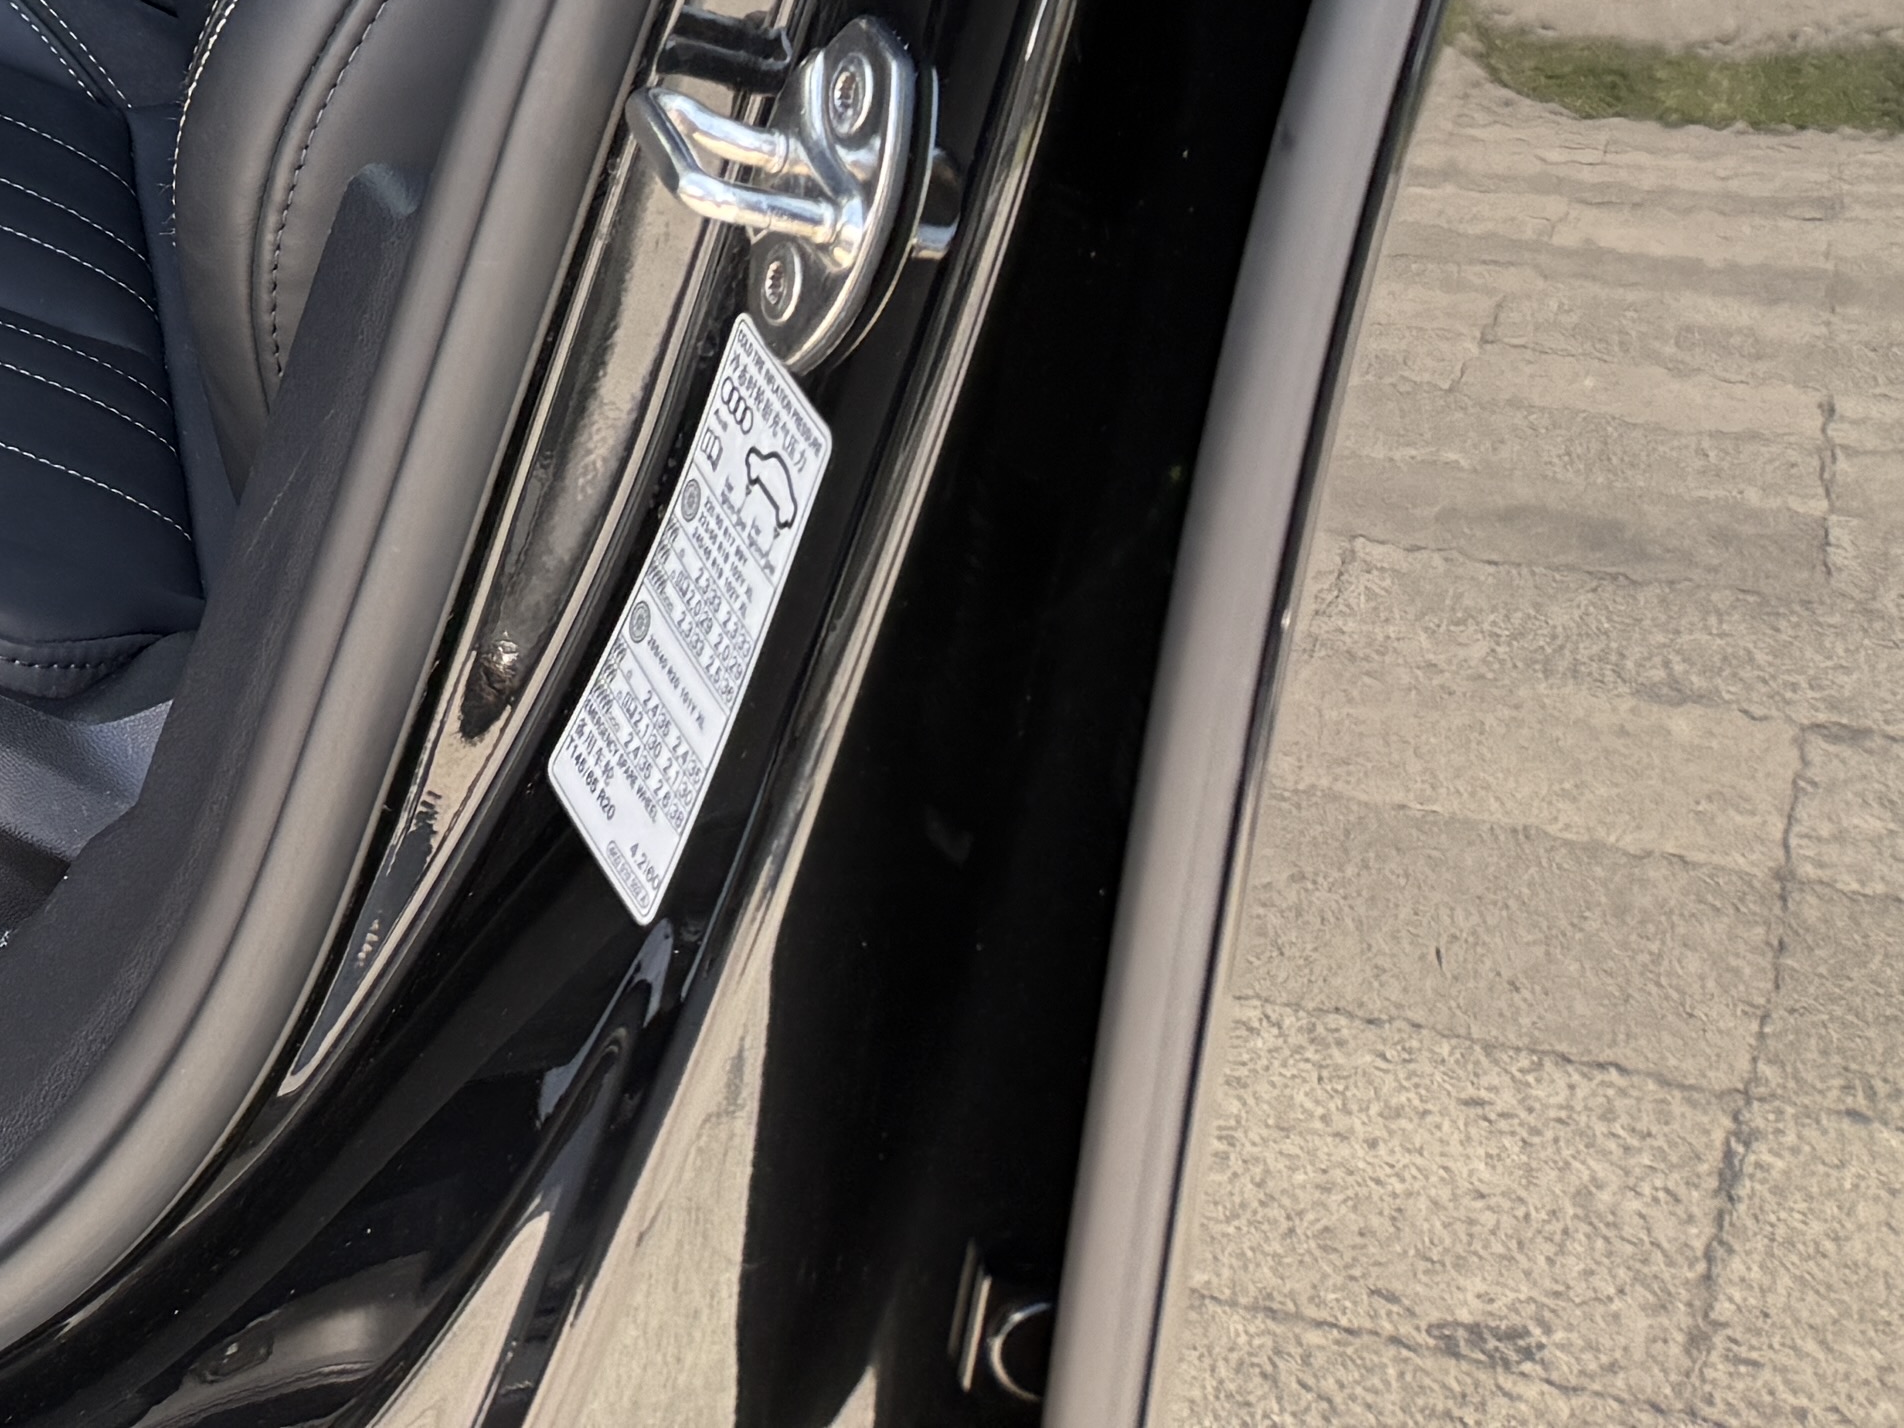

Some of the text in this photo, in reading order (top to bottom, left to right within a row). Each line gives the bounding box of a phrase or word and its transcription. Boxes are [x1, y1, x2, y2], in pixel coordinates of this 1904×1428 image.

[574, 718, 615, 786] 备用车轮
[596, 787, 616, 823] R20
